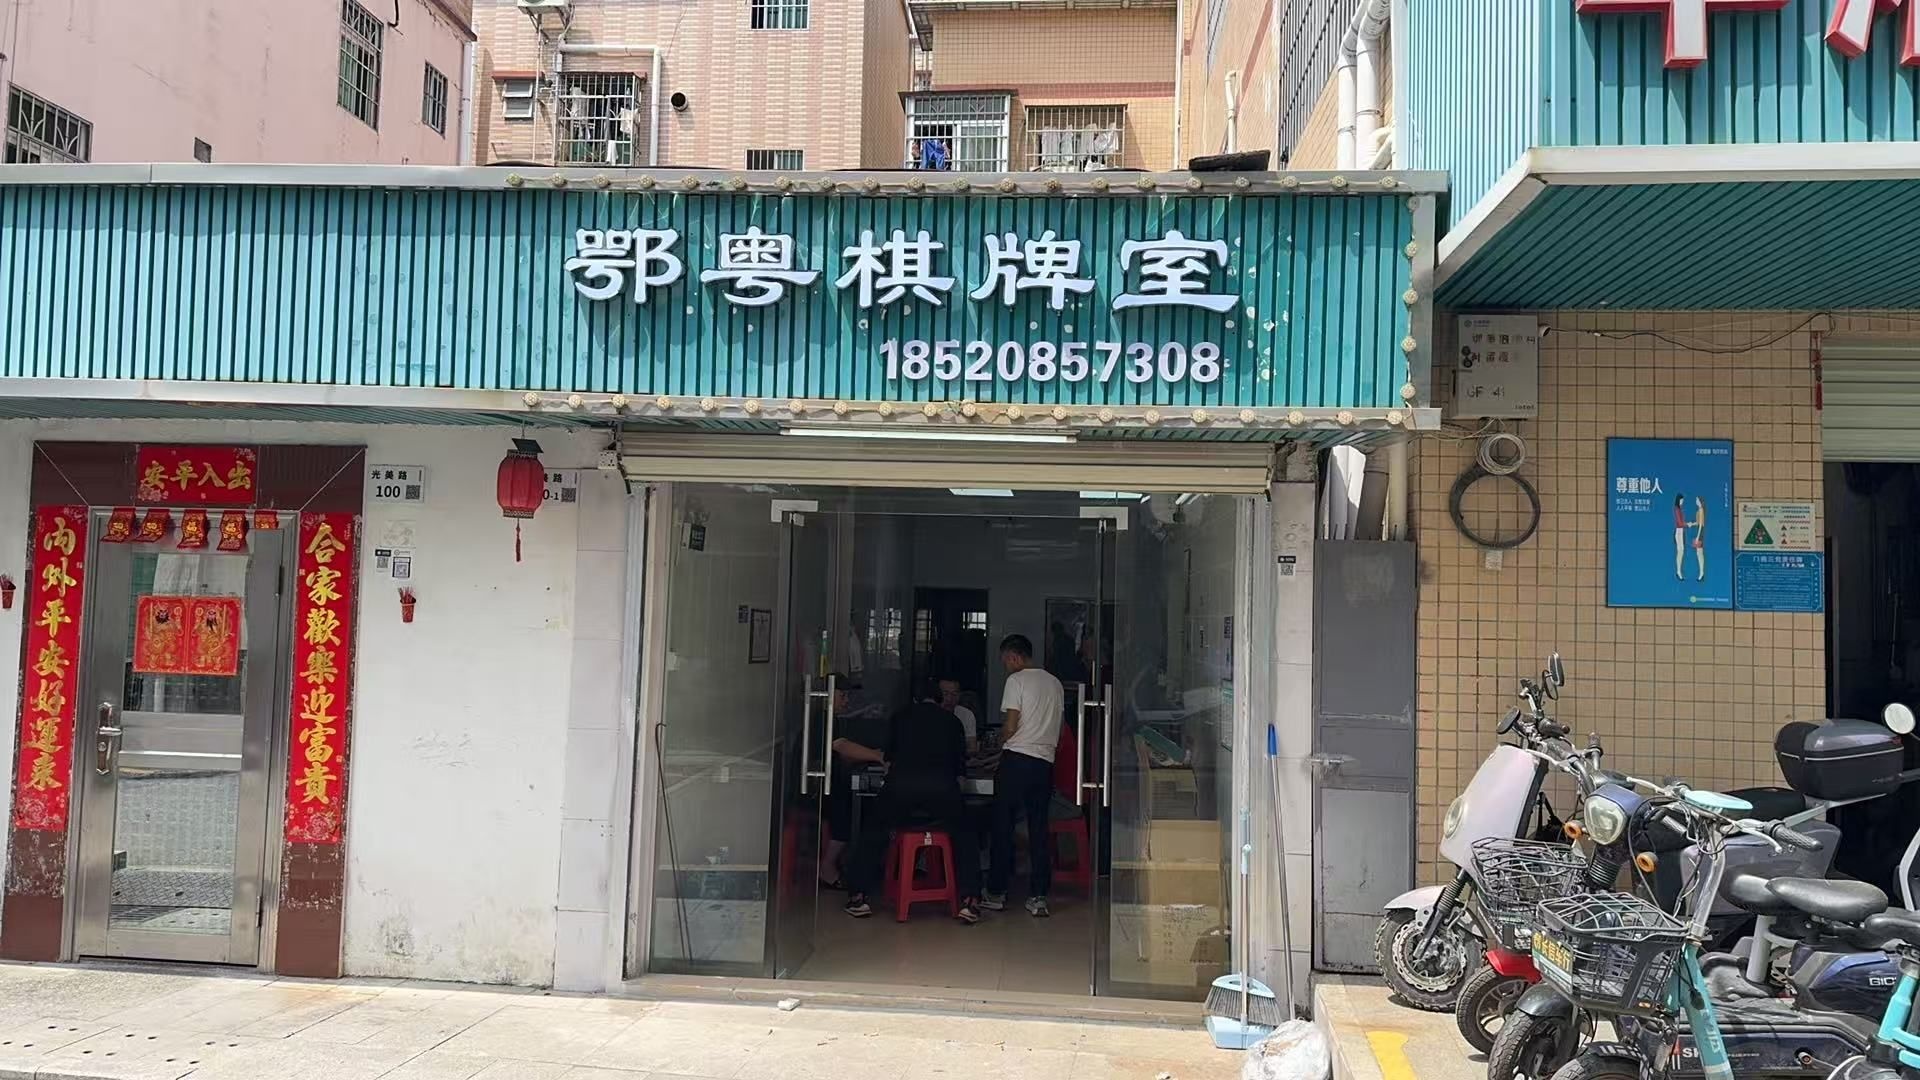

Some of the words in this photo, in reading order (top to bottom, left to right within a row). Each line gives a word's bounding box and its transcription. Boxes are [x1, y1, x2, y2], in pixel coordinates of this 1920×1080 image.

[564, 226, 1240, 314] 鄂粤棋牌室
[880, 338, 1222, 384] 18520857308
[371, 470, 407, 480] 光美路
[375, 485, 401, 498] 100
[1616, 477, 1663, 494] 尊重他人
[1869, 976, 1897, 986] GIC
